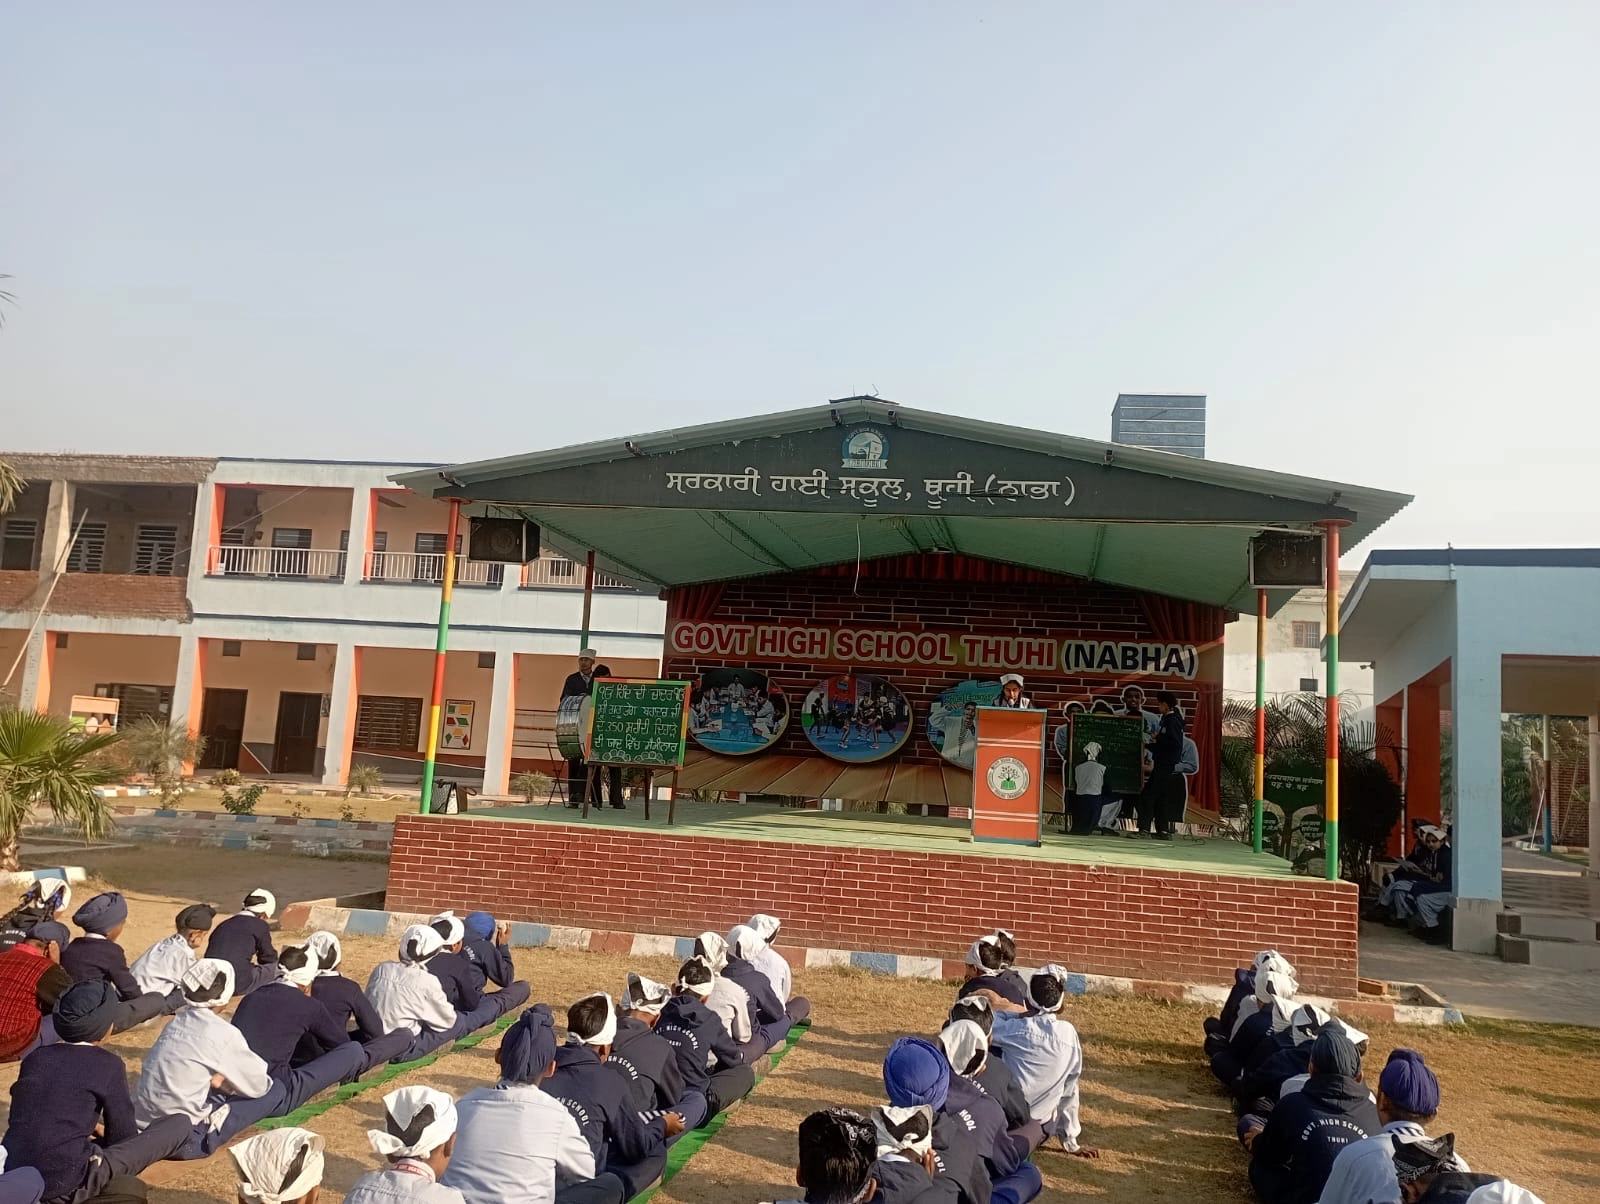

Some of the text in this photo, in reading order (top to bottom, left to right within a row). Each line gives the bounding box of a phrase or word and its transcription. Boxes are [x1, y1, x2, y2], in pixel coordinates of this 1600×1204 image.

[666, 467, 761, 496] ਸਰਕਾਰੀ
[769, 468, 830, 499] ਹਾਈ
[838, 476, 912, 507] ਸਕੂਲ,
[985, 474, 1075, 506] (ਨਾਭਾ)
[673, 624, 1196, 678] GOVT HIGH SCHOOL THUHI (NABHA)
[616, 684, 631, 699] ਹਿੰਦ
[633, 684, 647, 699] ਦੀ
[650, 688, 673, 701] ਚਾਦਰ
[640, 706, 669, 718] ਬਹਾਦਰ
[670, 702, 681, 718] ਜੀ
[596, 717, 606, 732] ਦੇ
[607, 721, 624, 732] 350
[594, 733, 604, 748] ਦੀ
[625, 733, 640, 750] ਵਿੱਚ
[618, 1057, 638, 1081] SCHOOL
[566, 1098, 590, 1127] SCHOOL
[1319, 1118, 1340, 1127] HIGH
[1342, 1120, 1368, 1140] SCHOO
